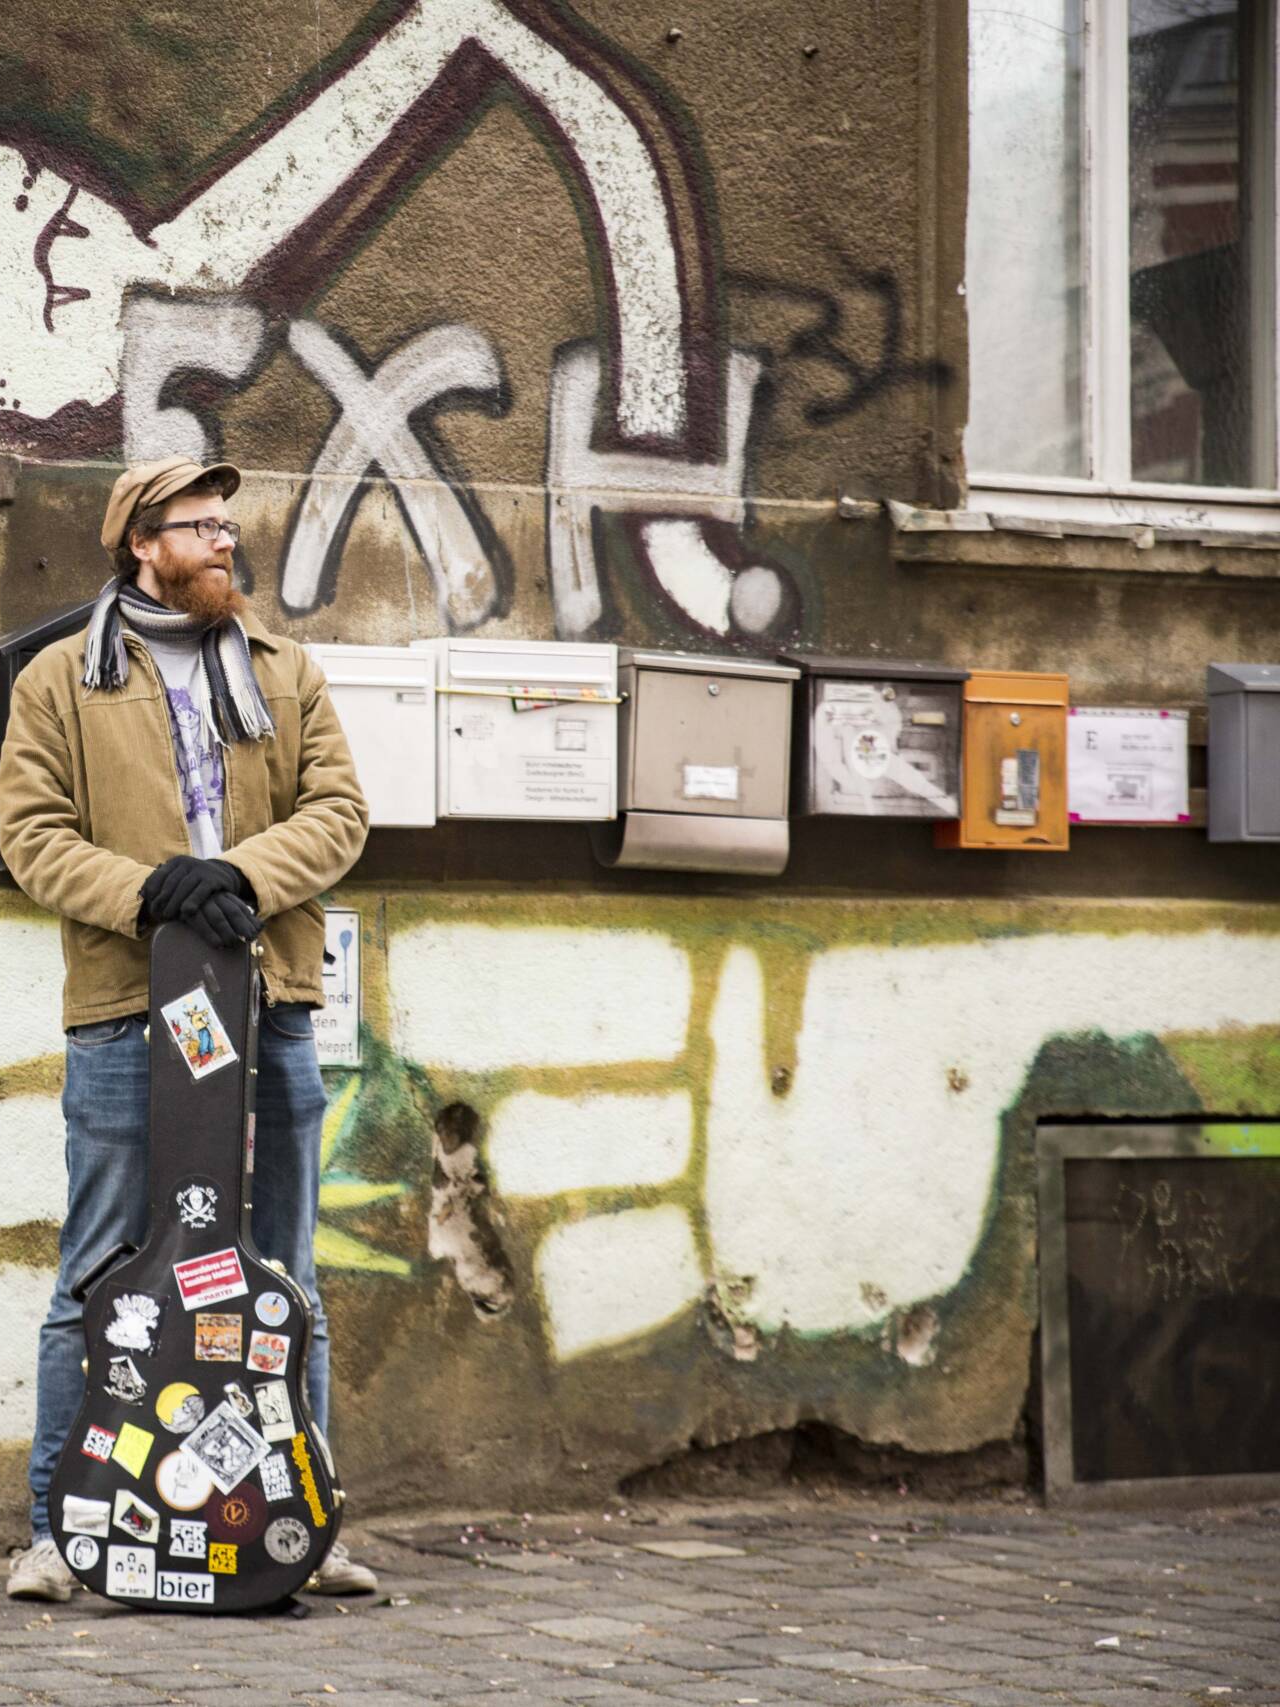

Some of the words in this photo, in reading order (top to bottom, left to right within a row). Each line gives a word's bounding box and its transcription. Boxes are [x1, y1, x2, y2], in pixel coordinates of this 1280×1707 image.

[170, 1524, 207, 1541] FCK
[169, 1537, 207, 1555] AFD
[160, 1575, 211, 1599] bier
